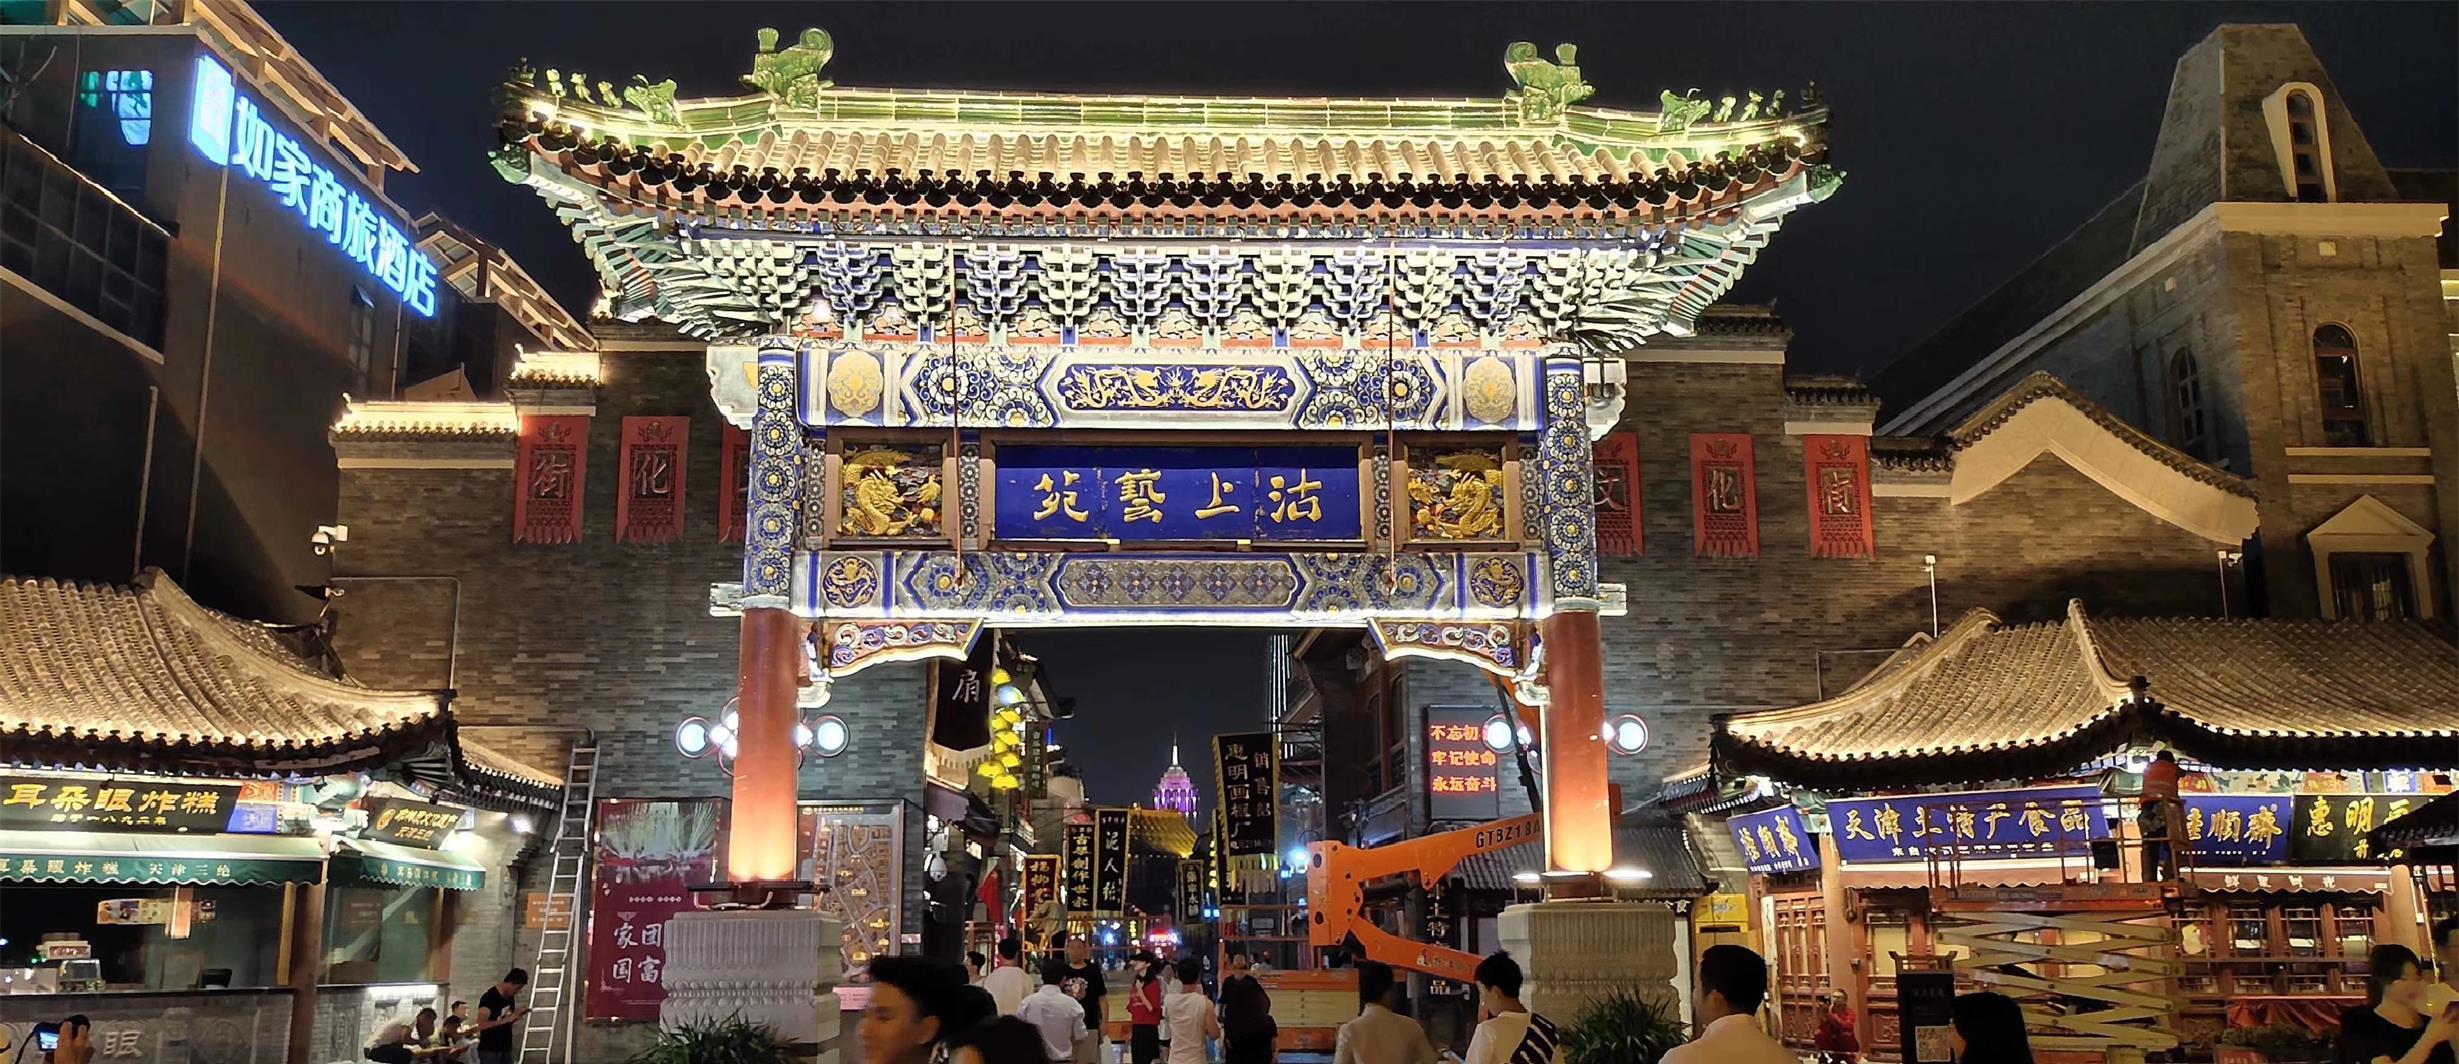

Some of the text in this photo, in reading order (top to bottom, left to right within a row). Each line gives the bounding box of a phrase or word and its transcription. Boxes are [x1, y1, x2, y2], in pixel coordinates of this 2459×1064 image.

[231, 94, 438, 318] 如家商旅酒店
[634, 453, 670, 496] 化
[1595, 468, 1626, 511] 文
[1706, 468, 1740, 512] 化
[1429, 724, 1482, 742] 不忘初
[1431, 750, 1497, 767] 牢记使命
[3, 783, 221, 816] 耳朵眼炸糕
[1432, 775, 1498, 793] 永远奋斗
[1845, 799, 2091, 846] 天津土特产食品
[149, 863, 232, 878] 天津三绝
